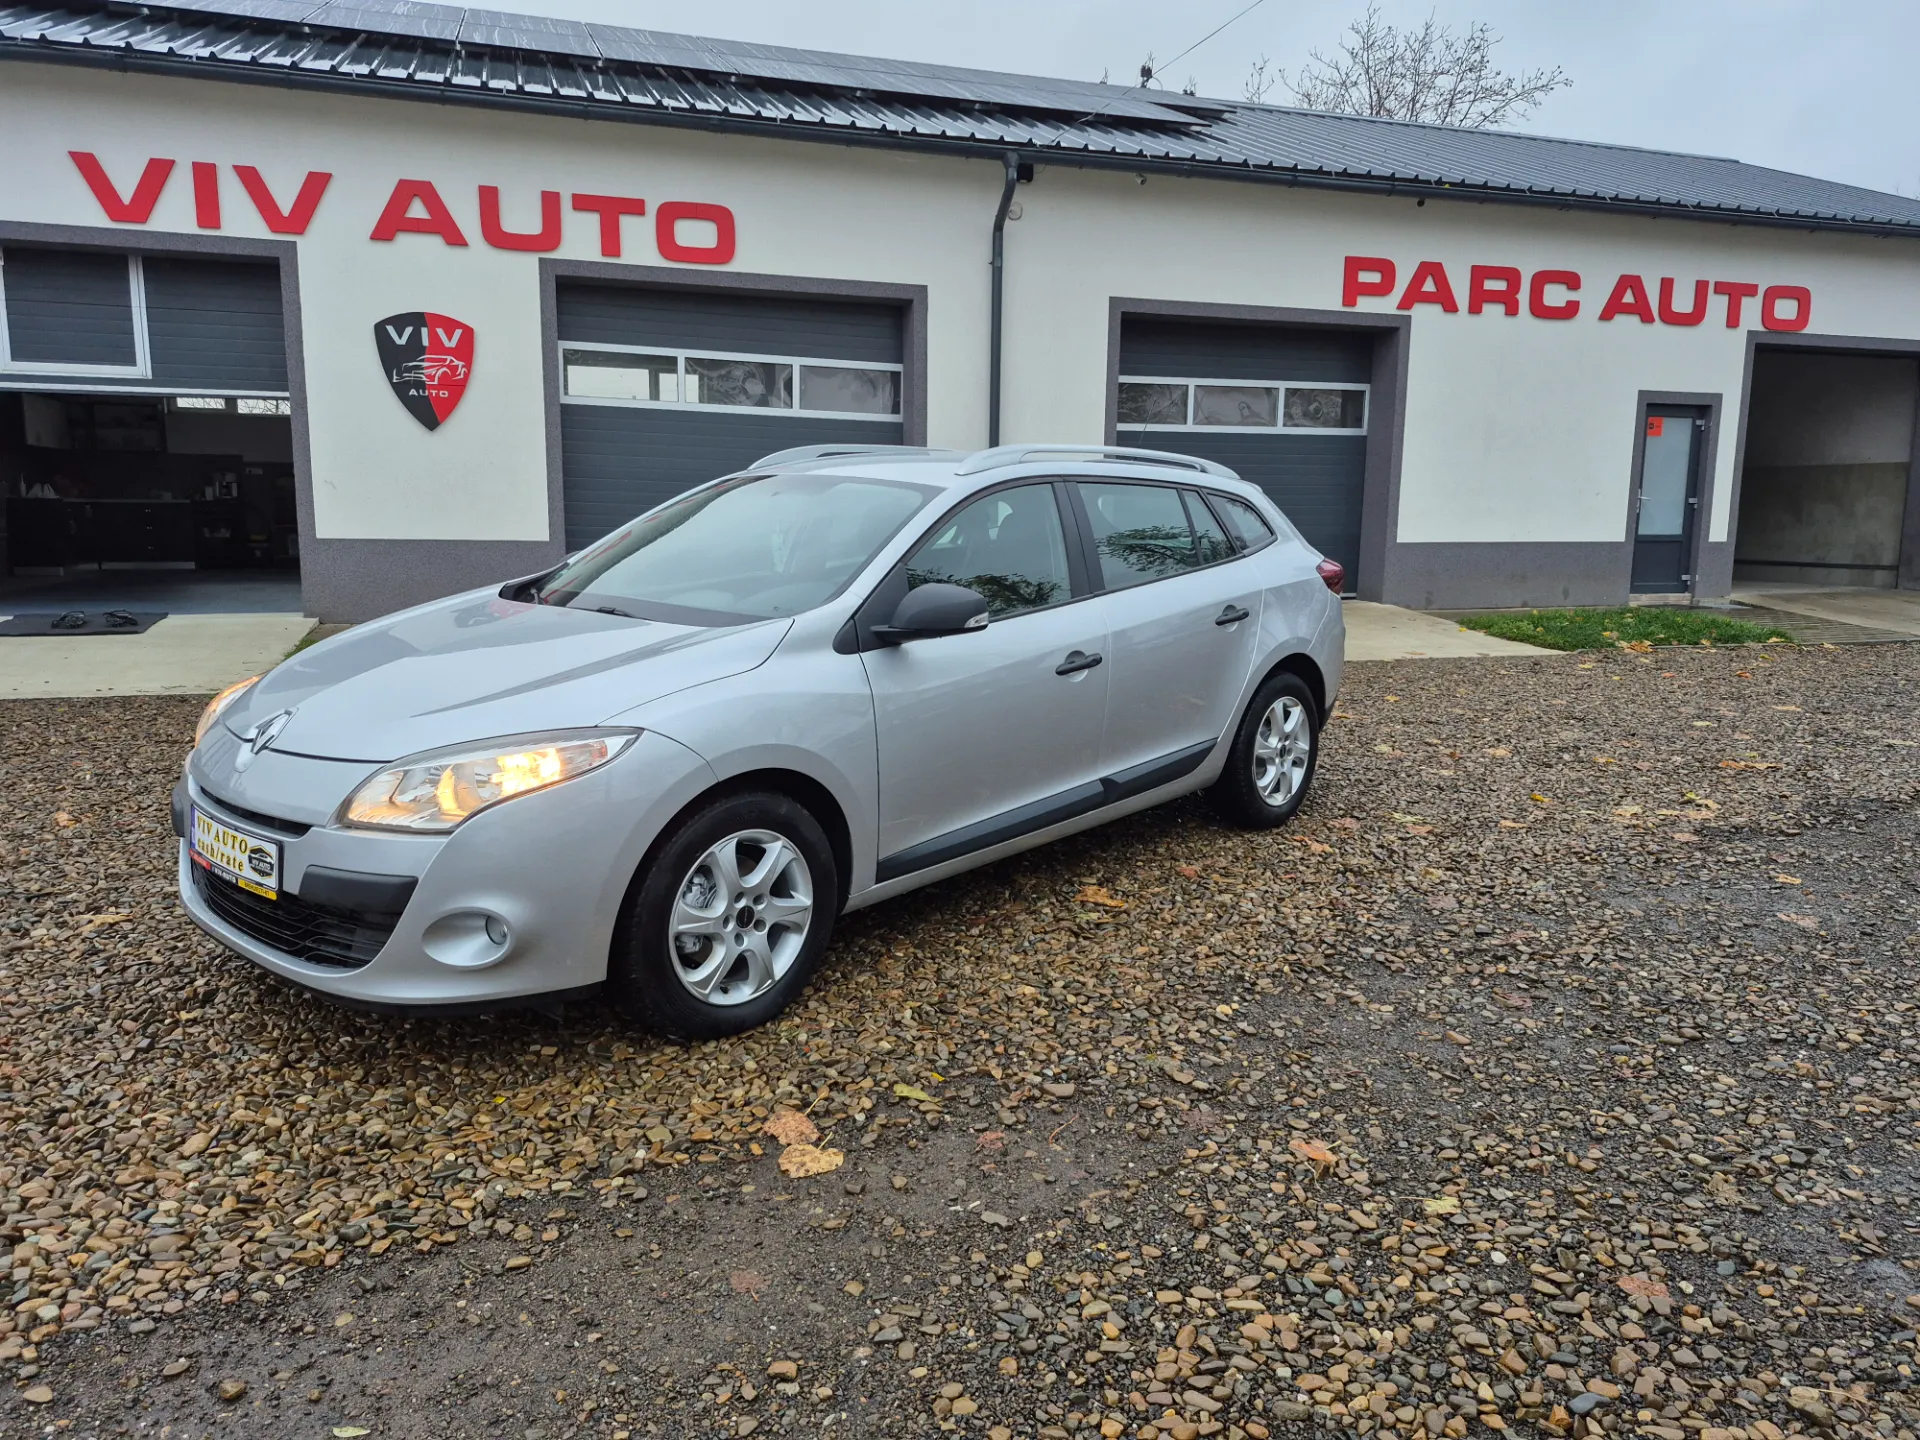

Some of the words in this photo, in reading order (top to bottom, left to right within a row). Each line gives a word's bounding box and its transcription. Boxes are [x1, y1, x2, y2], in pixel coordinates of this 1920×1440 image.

[69, 151, 332, 235] VIV
[370, 179, 737, 265] AUTO
[1342, 255, 1582, 320] PARC
[1599, 274, 1812, 332] AUTO
[385, 325, 463, 348] VIV
[408, 388, 449, 398] AUTO
[197, 815, 213, 838] VIV
[213, 826, 248, 855] AUTO
[197, 838, 244, 872] cash/rate
